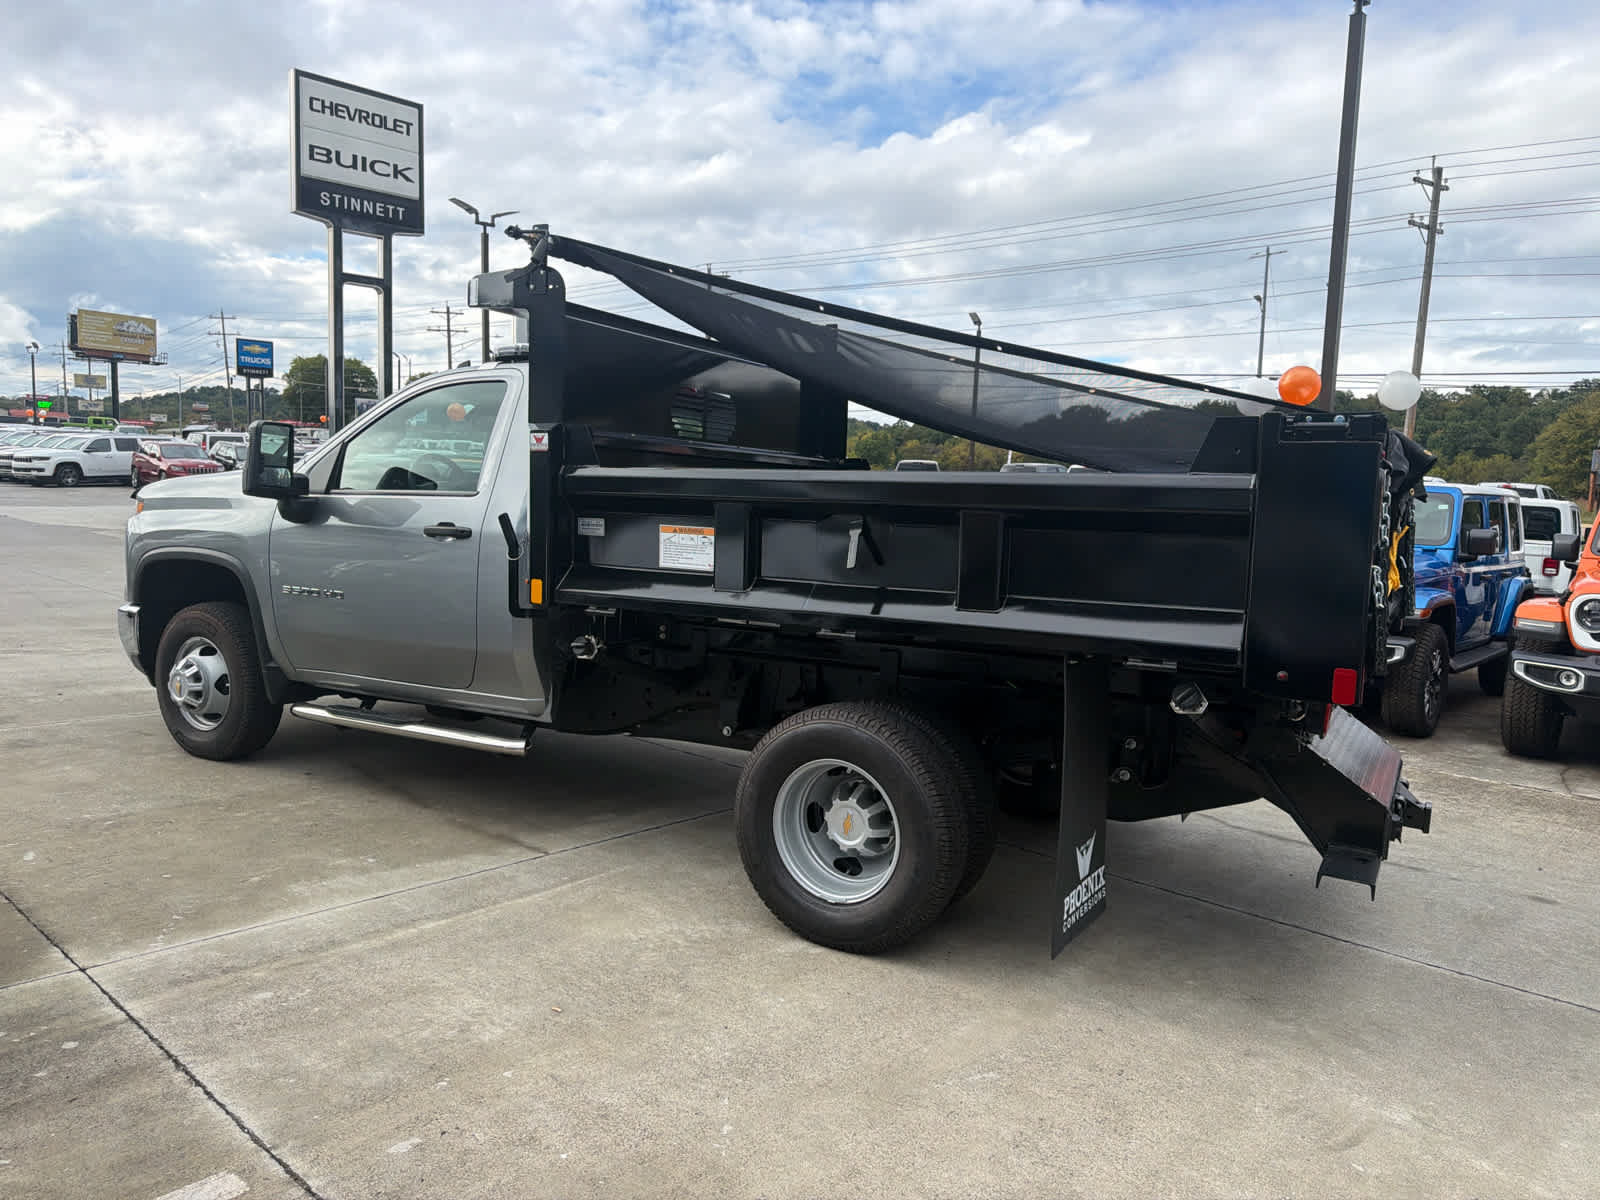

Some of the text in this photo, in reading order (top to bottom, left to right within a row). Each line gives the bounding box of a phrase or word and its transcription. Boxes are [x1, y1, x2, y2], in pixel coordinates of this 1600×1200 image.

[309, 96, 414, 136] CHEVROLET
[308, 143, 415, 184] BUICK
[320, 191, 406, 221] STINNETT
[240, 355, 272, 365] TRUCKS
[1062, 887, 1107, 933] CONVERSIONS
[1063, 864, 1106, 921] PHOENIX
